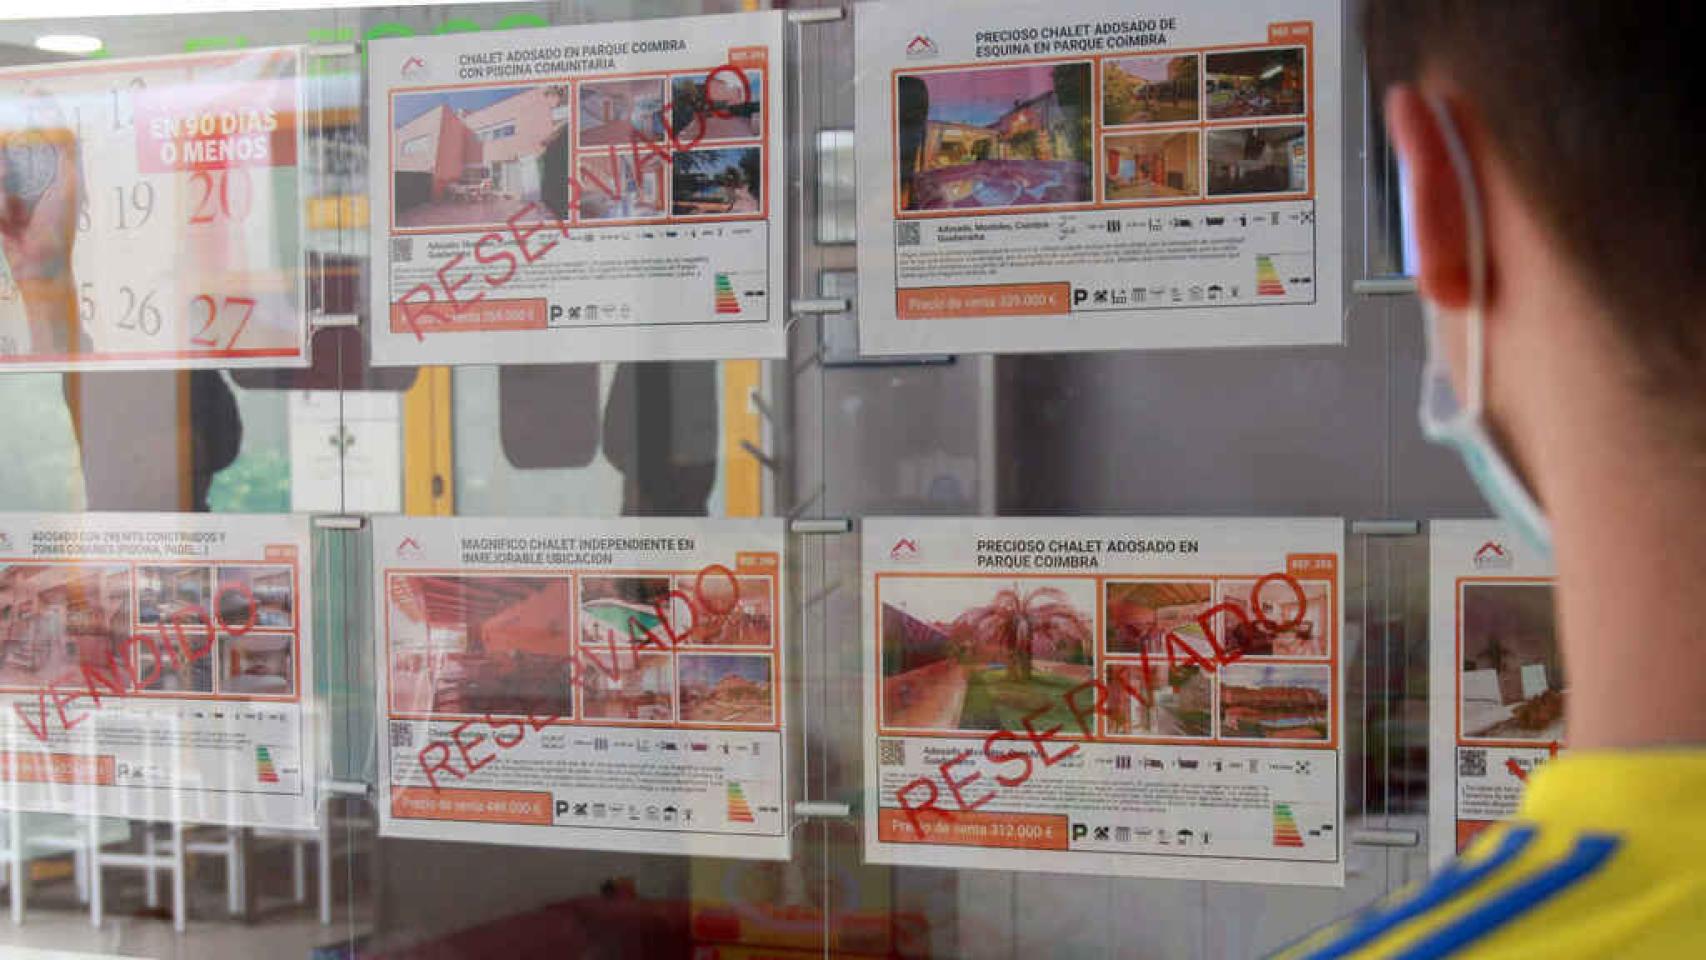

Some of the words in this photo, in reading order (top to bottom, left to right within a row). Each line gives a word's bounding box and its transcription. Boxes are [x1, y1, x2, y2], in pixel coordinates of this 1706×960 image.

[974, 27, 1039, 43] PRECIOSO
[1041, 24, 1090, 39] CHALET
[1093, 20, 1157, 35] ADOSADO
[1160, 17, 1176, 31] DE
[458, 52, 503, 65] CHALET
[506, 48, 562, 62] ADOSADO
[564, 47, 580, 59] EN
[582, 43, 628, 57] PARQUE
[631, 40, 687, 54] COIMBRA
[974, 43, 1033, 58] ESQUINA
[1034, 41, 1050, 54] EN
[1053, 37, 1104, 52] PARQUE
[458, 67, 483, 79] CON
[485, 63, 532, 77] PISCINA
[534, 58, 616, 75] COMUNITARIA
[185, 114, 215, 135] 90
[183, 136, 268, 164] MENOS
[114, 181, 154, 231] 19
[1074, 289, 1088, 305] P
[117, 284, 162, 337] 26
[190, 294, 257, 352] 27
[529, 537, 576, 551] CHALET
[578, 537, 675, 552] INDEPENDIENTE
[677, 538, 695, 552] EN
[977, 539, 1046, 552] PRECIOSO
[1048, 539, 1102, 552] CHALET
[1107, 539, 1176, 553] ADOSADO
[1179, 541, 1199, 553] EN
[461, 550, 547, 565] INMEJORABLE
[977, 554, 1031, 568] PARQUE
[1033, 555, 1099, 568] COIMBRA
[13, 581, 257, 742] VENDIDO
[895, 572, 1307, 840] RESERVADO
[1073, 824, 1087, 841] P
